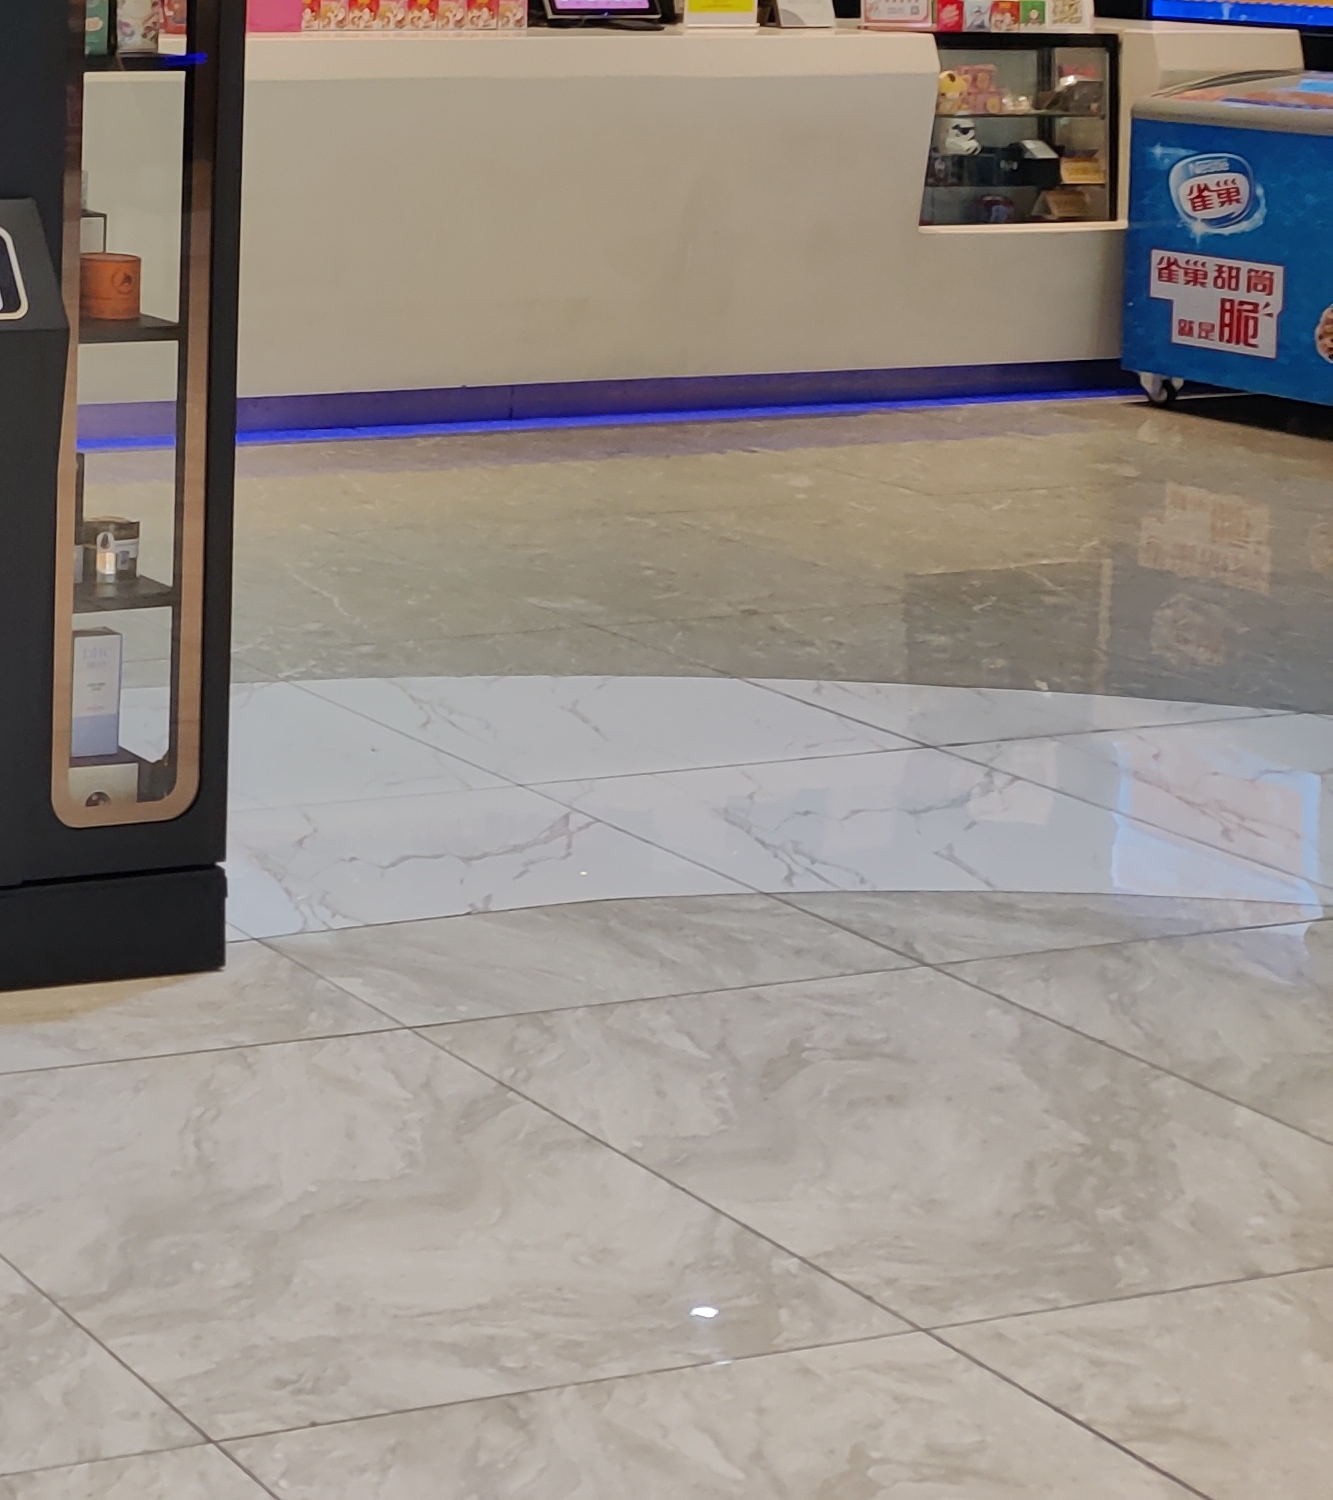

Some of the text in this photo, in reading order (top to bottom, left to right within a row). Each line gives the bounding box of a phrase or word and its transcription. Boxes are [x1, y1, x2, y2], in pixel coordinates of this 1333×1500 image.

[1188, 178, 1242, 212] 雀巢
[1157, 256, 1275, 296] 雀巢甜筒
[1177, 297, 1261, 349] 就是脆
